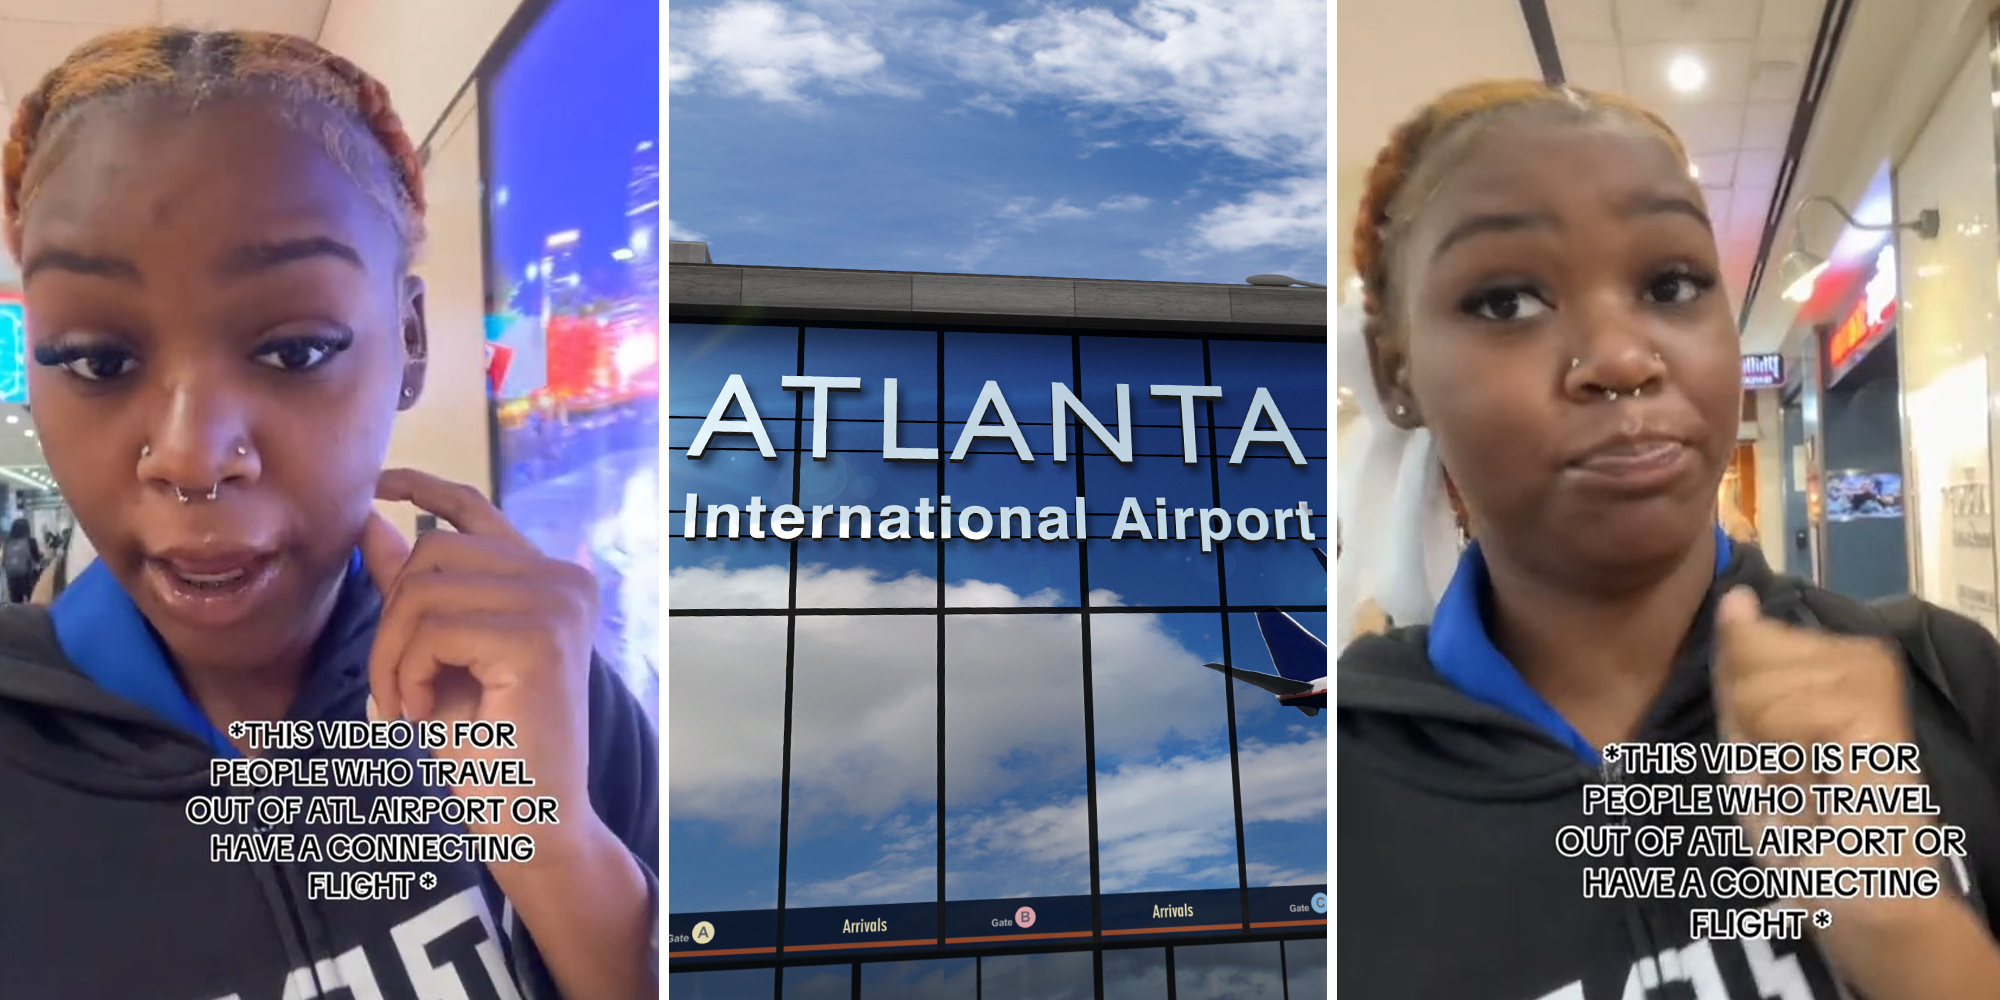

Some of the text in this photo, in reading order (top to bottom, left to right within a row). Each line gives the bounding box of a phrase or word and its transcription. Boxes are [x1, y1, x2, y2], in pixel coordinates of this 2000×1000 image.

[686, 374, 1308, 466] ATLANTA
[684, 493, 1316, 554] International Airport
[1152, 903, 1194, 919] Arrivals
[1289, 896, 1325, 913] Gate C
[842, 918, 888, 934] Arrivals
[991, 911, 1031, 927] Gate B
[697, 926, 709, 938] A
